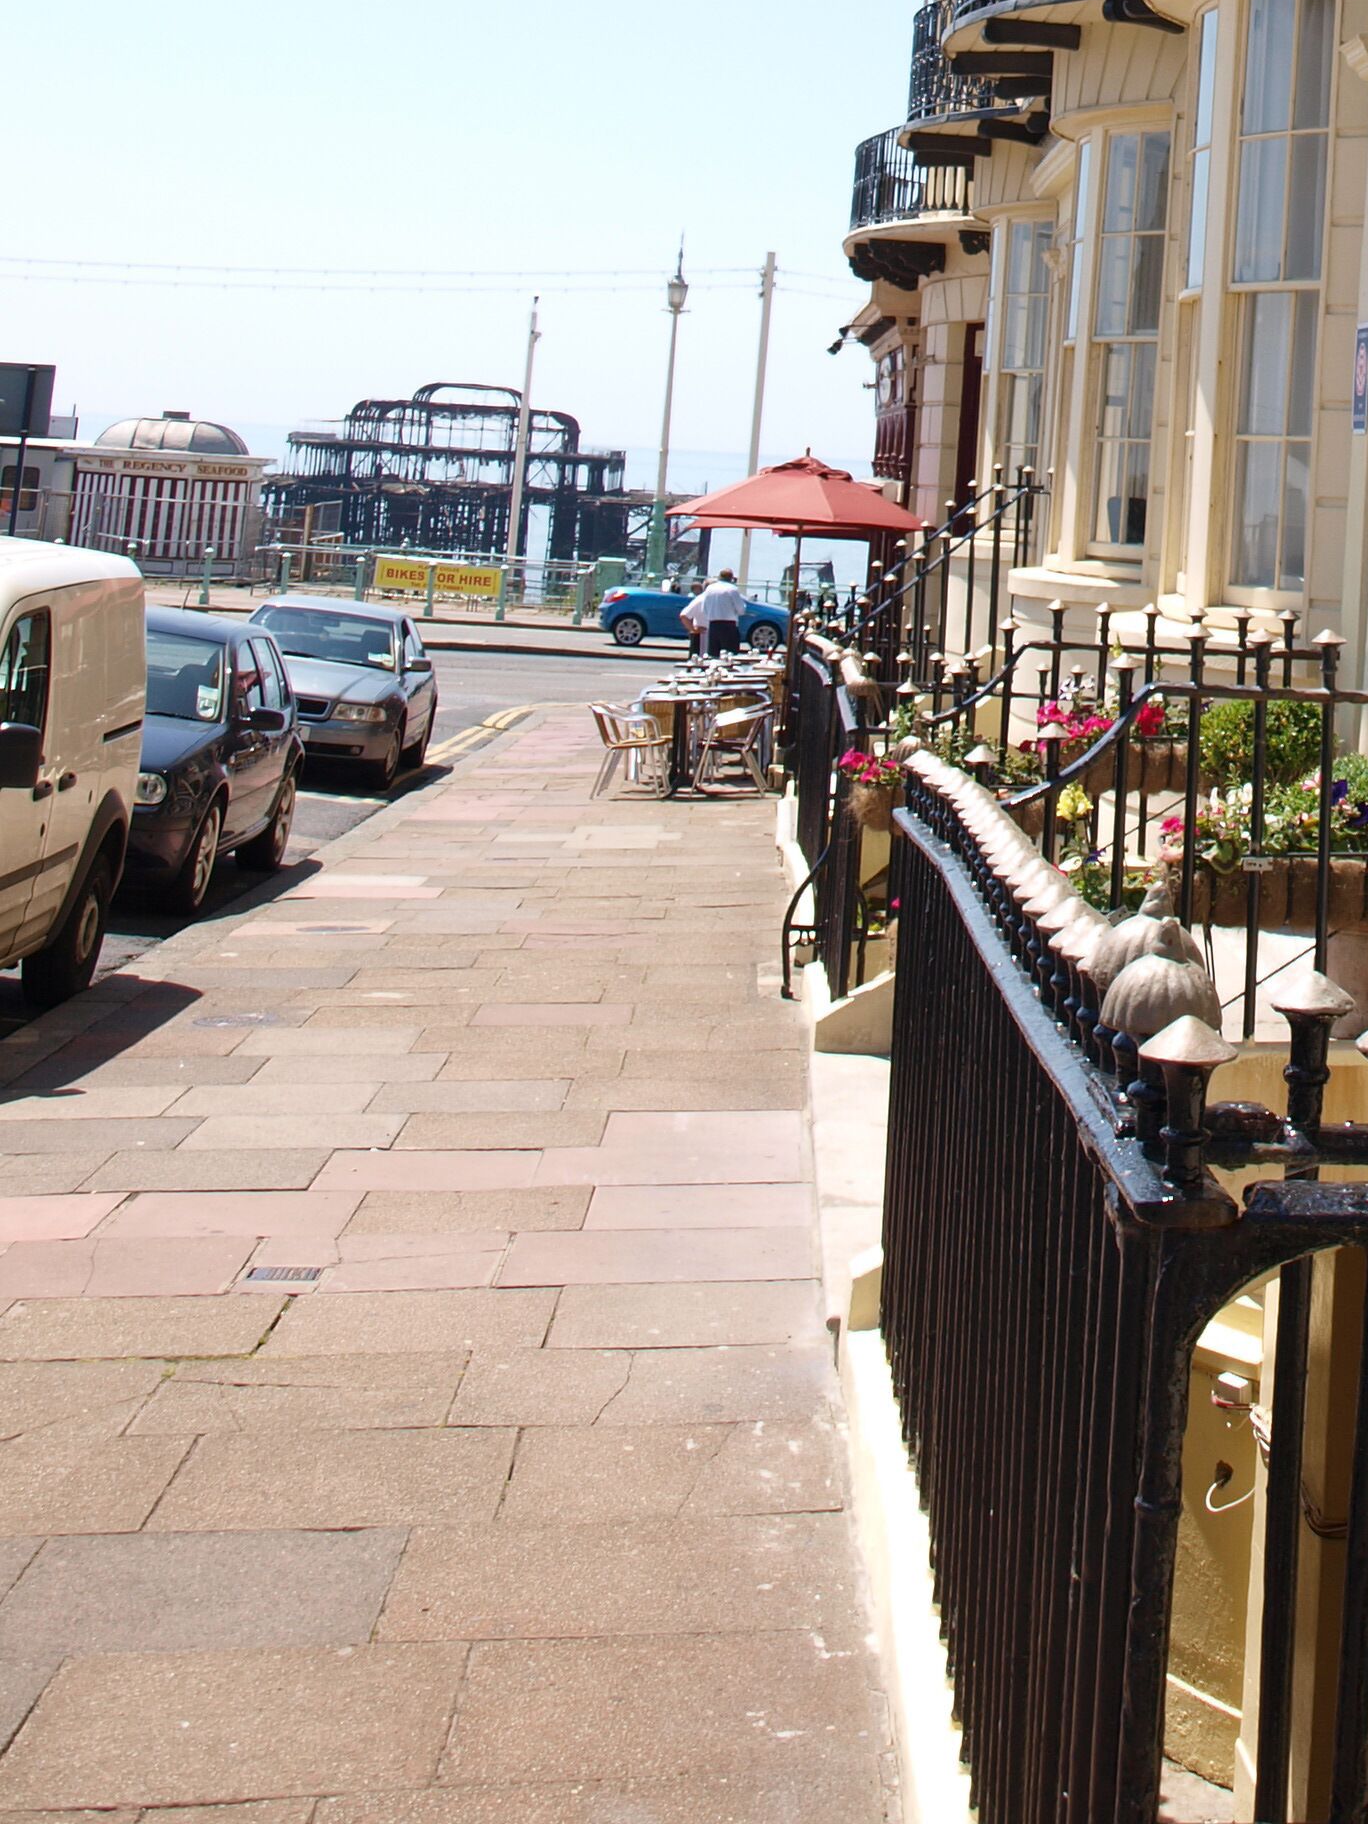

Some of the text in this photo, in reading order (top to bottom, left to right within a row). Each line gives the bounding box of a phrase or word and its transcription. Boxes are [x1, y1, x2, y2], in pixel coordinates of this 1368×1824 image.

[123, 460, 187, 473] REGENCY
[197, 463, 248, 476] SEAFOOD
[386, 568, 425, 581] BIKES
[433, 572, 455, 584] OR
[459, 575, 492, 587] HIRE
